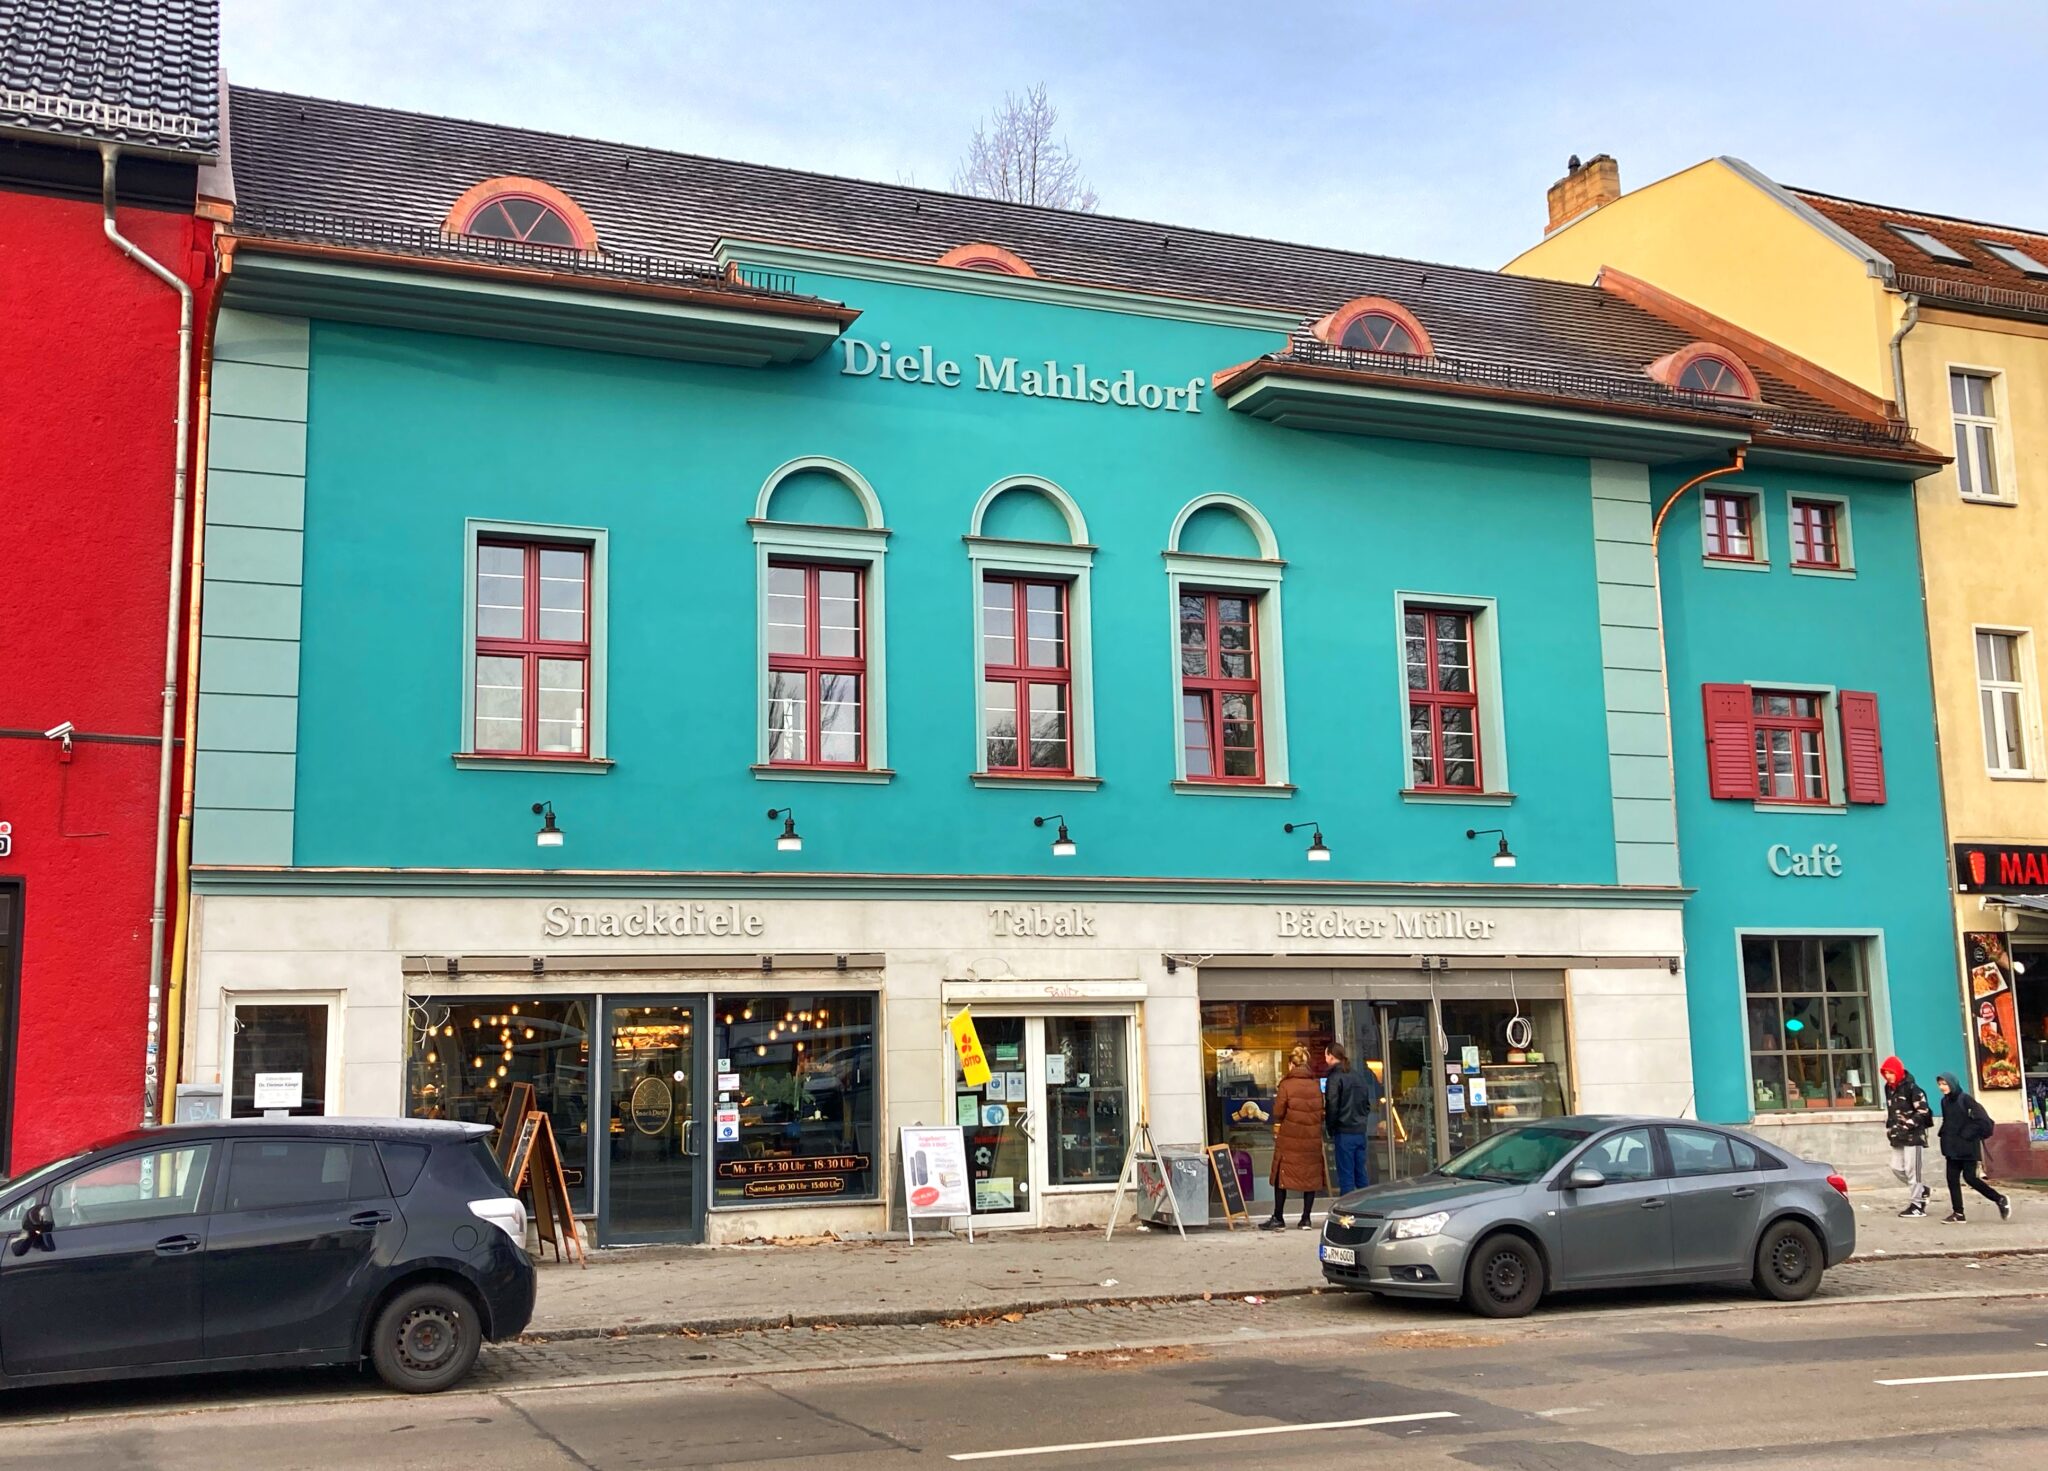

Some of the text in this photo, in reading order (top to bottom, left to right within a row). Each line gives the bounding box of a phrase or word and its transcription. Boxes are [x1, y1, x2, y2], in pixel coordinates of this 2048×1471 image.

[840, 338, 1204, 412] Diele Mahlsdorf
[1767, 843, 1843, 878] Café
[545, 903, 764, 938] Snackdiele
[989, 906, 1096, 938] Tabak
[1277, 909, 1495, 939] Bäcker Müller
[960, 1055, 981, 1068] LOTTO
[733, 1164, 747, 1174] Mo
[754, 1162, 766, 1173] Fr:
[768, 1161, 789, 1173] 5:30
[790, 1160, 805, 1171] Uhr
[814, 1159, 838, 1170] 18:30
[840, 1158, 855, 1168] Uhr
[778, 1183, 796, 1191] 10:30
[829, 1180, 841, 1188] Uhr
